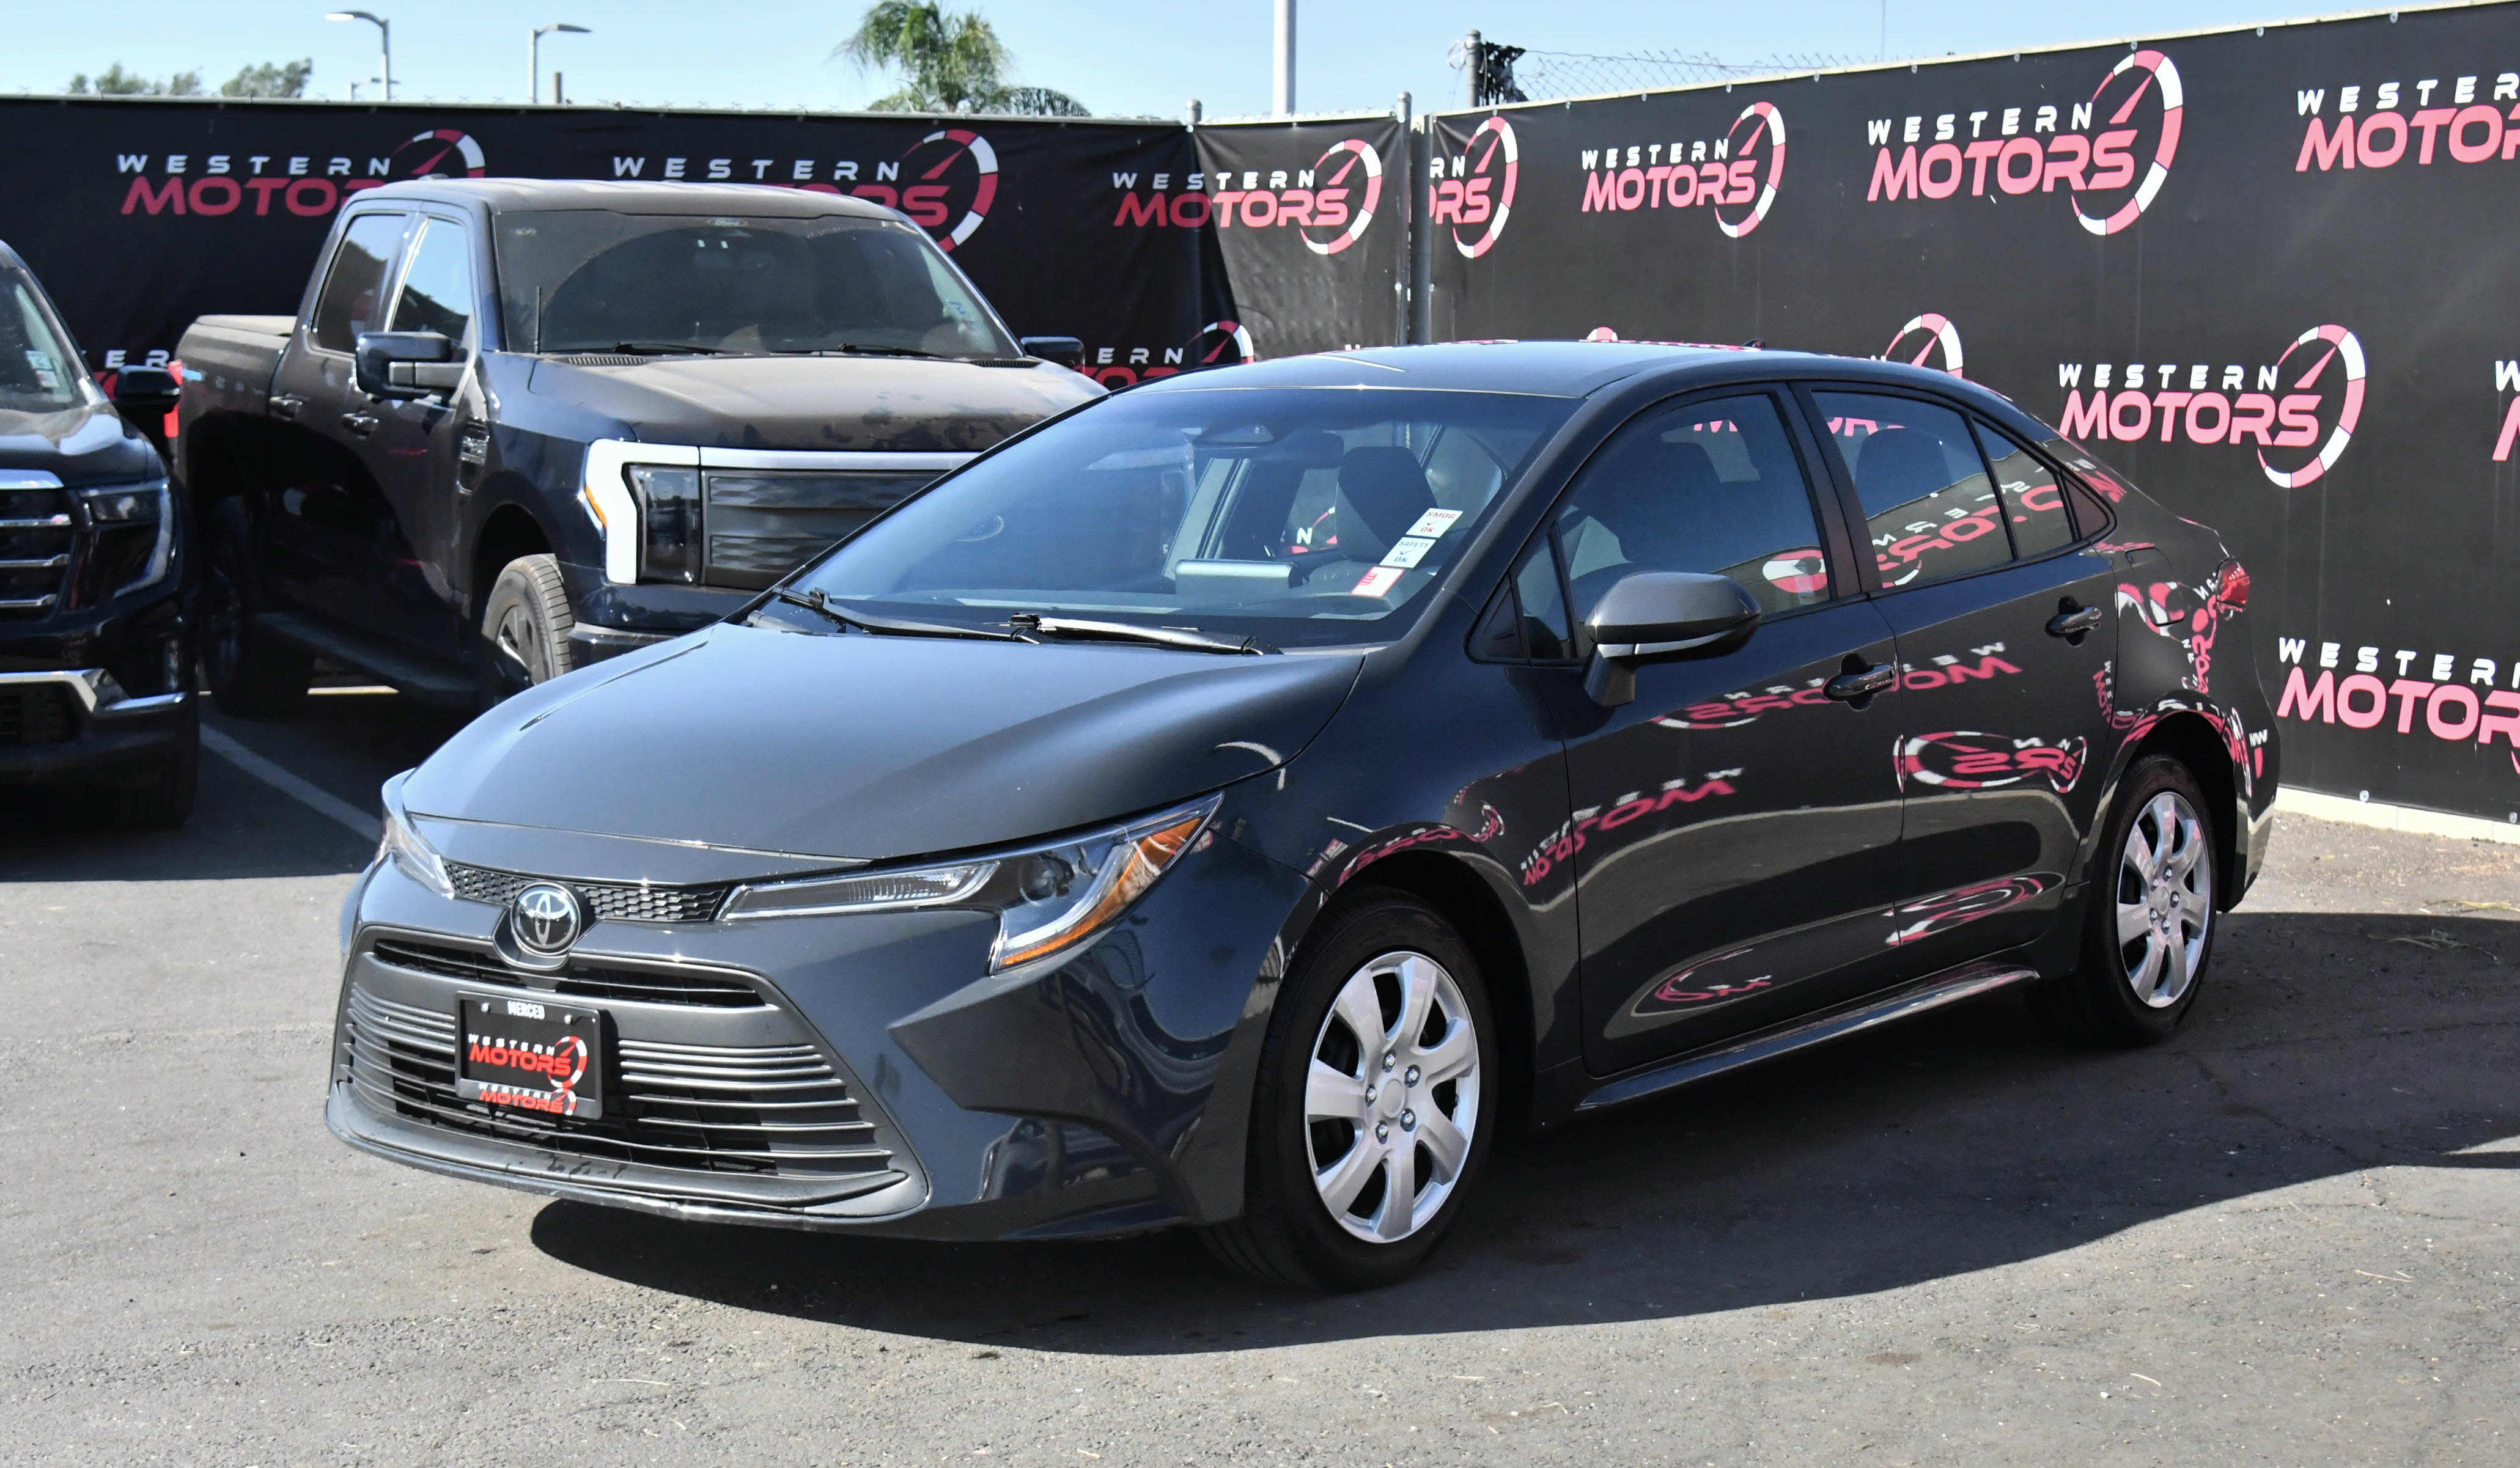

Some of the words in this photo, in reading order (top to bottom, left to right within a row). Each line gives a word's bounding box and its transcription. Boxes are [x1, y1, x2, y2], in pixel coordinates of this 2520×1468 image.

[2298, 73, 2519, 116] WESTER
[1868, 103, 2093, 145] WESTERN
[119, 155, 390, 175] WESTERN
[615, 158, 899, 180] WESTERN
[1582, 139, 1729, 170] WESTERN
[1868, 129, 2137, 202] MOTORS
[1114, 170, 1315, 189] WESTERN
[1582, 160, 1757, 212] MOTORS
[1115, 189, 1349, 227] MOTORS
[2059, 364, 2279, 391] WESTERN
[2059, 389, 2322, 447] MOTORS
[1426, 511, 1456, 519] SMOG
[2278, 667, 2520, 749] MOTOR
[507, 1000, 546, 1020] MERCED
[468, 1033, 555, 1056] WESTERN
[469, 1043, 571, 1076] MOTORS
[479, 1083, 551, 1101] WESTERN
[479, 1090, 564, 1114] MOTORS
